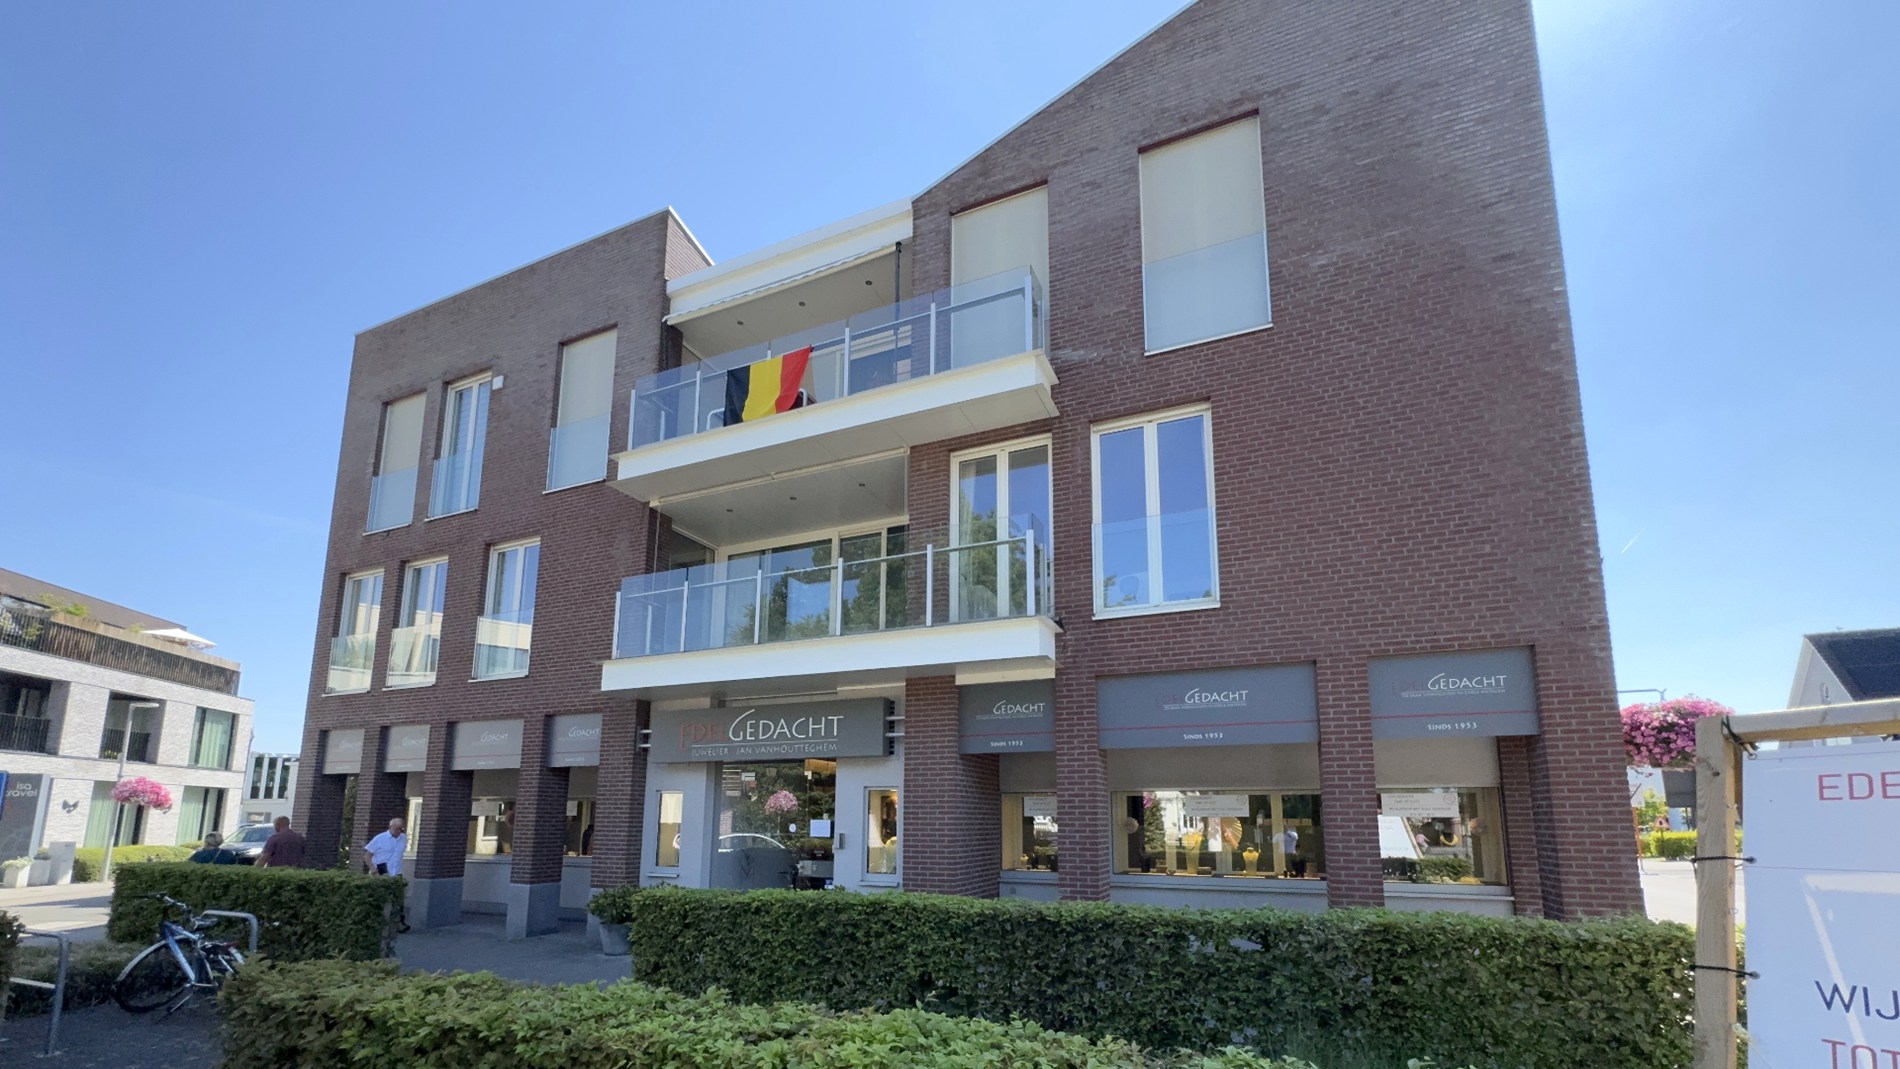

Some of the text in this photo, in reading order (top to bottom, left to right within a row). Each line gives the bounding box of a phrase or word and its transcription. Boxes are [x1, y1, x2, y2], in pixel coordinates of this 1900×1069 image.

[1427, 721, 1478, 731] SINDS 1953
[691, 743, 838, 757] JUWELIER JAN VANHOUTTEGHEM
[1814, 980, 1900, 1020] WIJ
